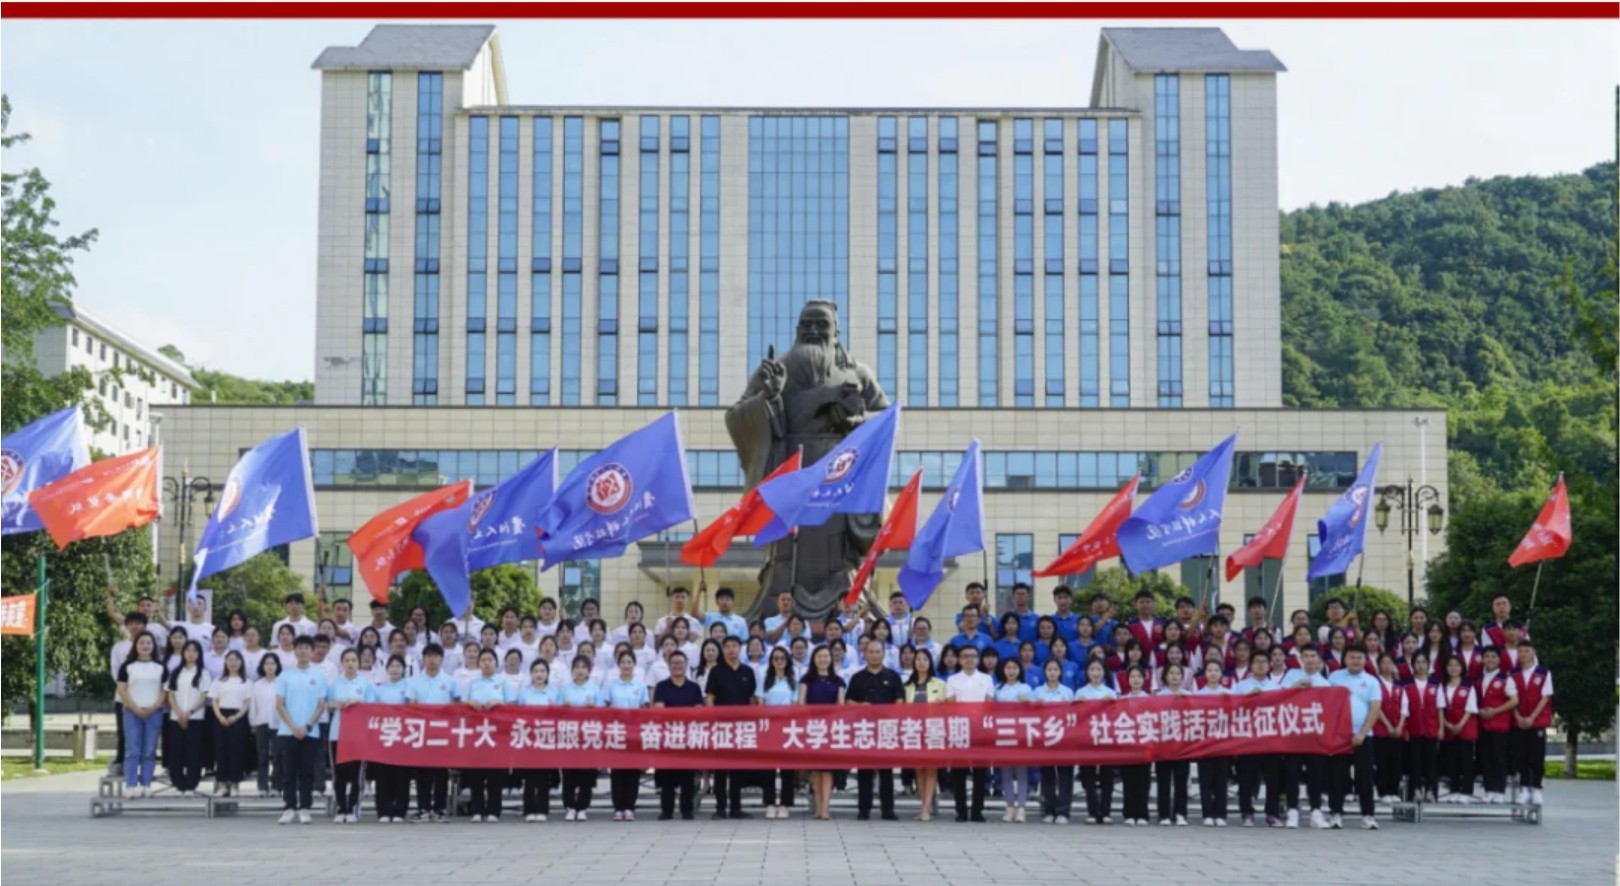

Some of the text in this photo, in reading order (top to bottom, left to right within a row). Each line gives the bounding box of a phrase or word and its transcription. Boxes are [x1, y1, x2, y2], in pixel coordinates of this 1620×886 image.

[368, 702, 1325, 750] “学习二十大 永远跟党走 奋进新征程” 大学生志愿者暑期 “三下乡” 社会实践活动出征仪式
